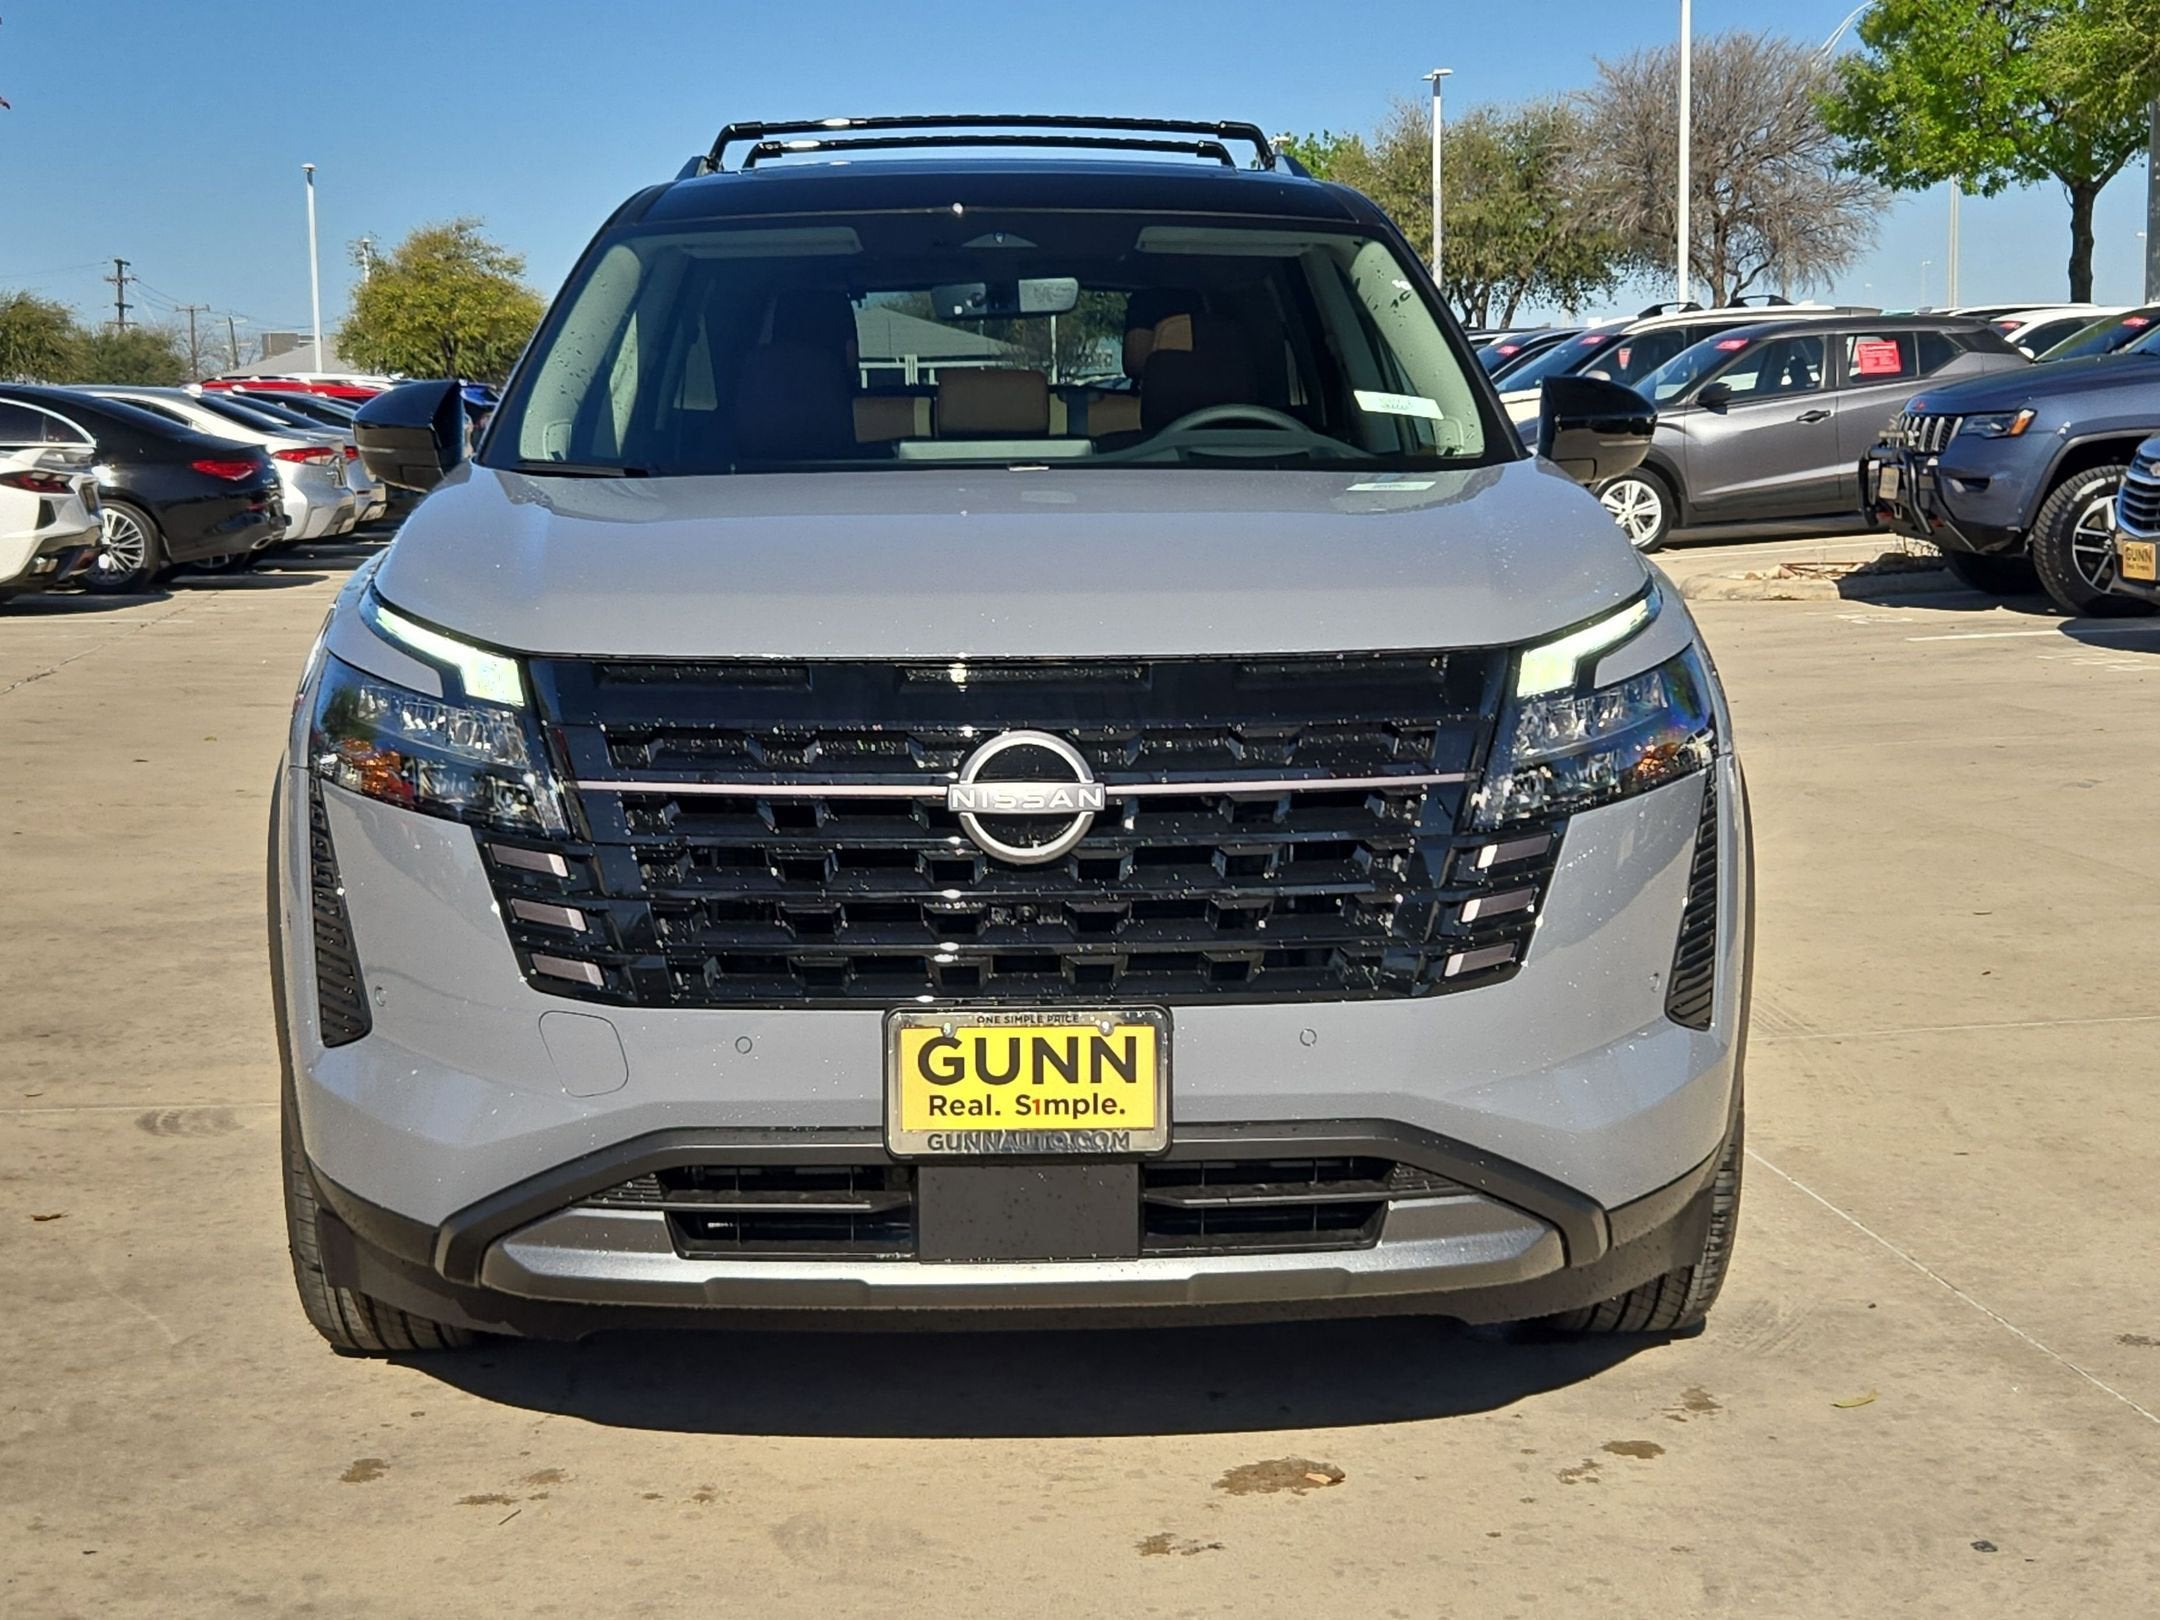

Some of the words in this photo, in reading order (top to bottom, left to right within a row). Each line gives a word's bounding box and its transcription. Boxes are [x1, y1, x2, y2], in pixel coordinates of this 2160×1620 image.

[952, 788, 1102, 809] NISSAN
[976, 1015, 1001, 1025] ONE
[1003, 1014, 1045, 1024] SIMPLE
[1047, 1013, 1080, 1024] PRICE
[917, 1035, 1137, 1086] GUNN
[929, 1094, 1001, 1117] Real.
[927, 1131, 1131, 1152] GUNNAUTO.COM
